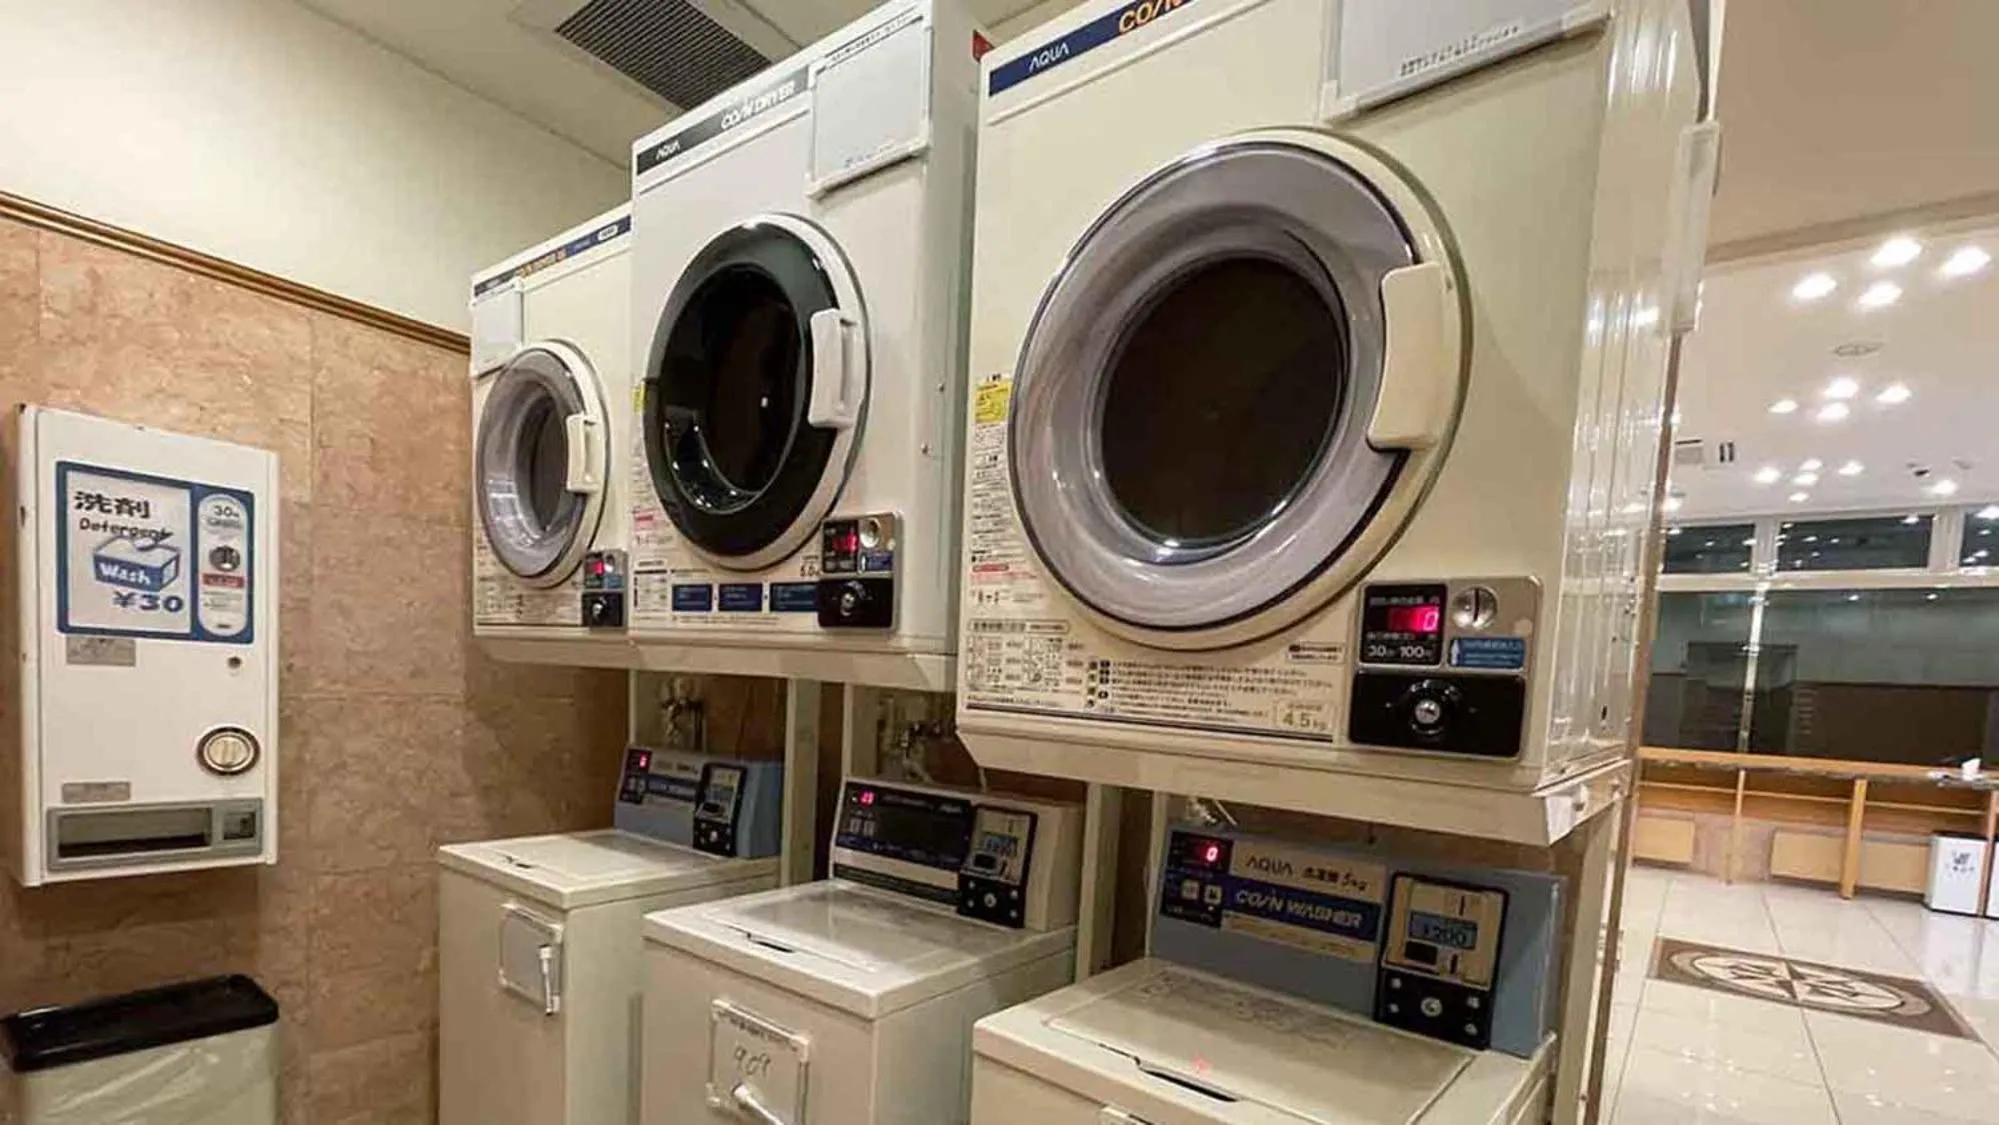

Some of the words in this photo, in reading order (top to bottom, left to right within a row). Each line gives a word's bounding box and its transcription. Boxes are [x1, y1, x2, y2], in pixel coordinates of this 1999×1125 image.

[1028, 42, 1070, 72] AQUA
[74, 490, 149, 518] 洗剤
[99, 563, 151, 585] Wash
[1246, 855, 1295, 877] AQUA
